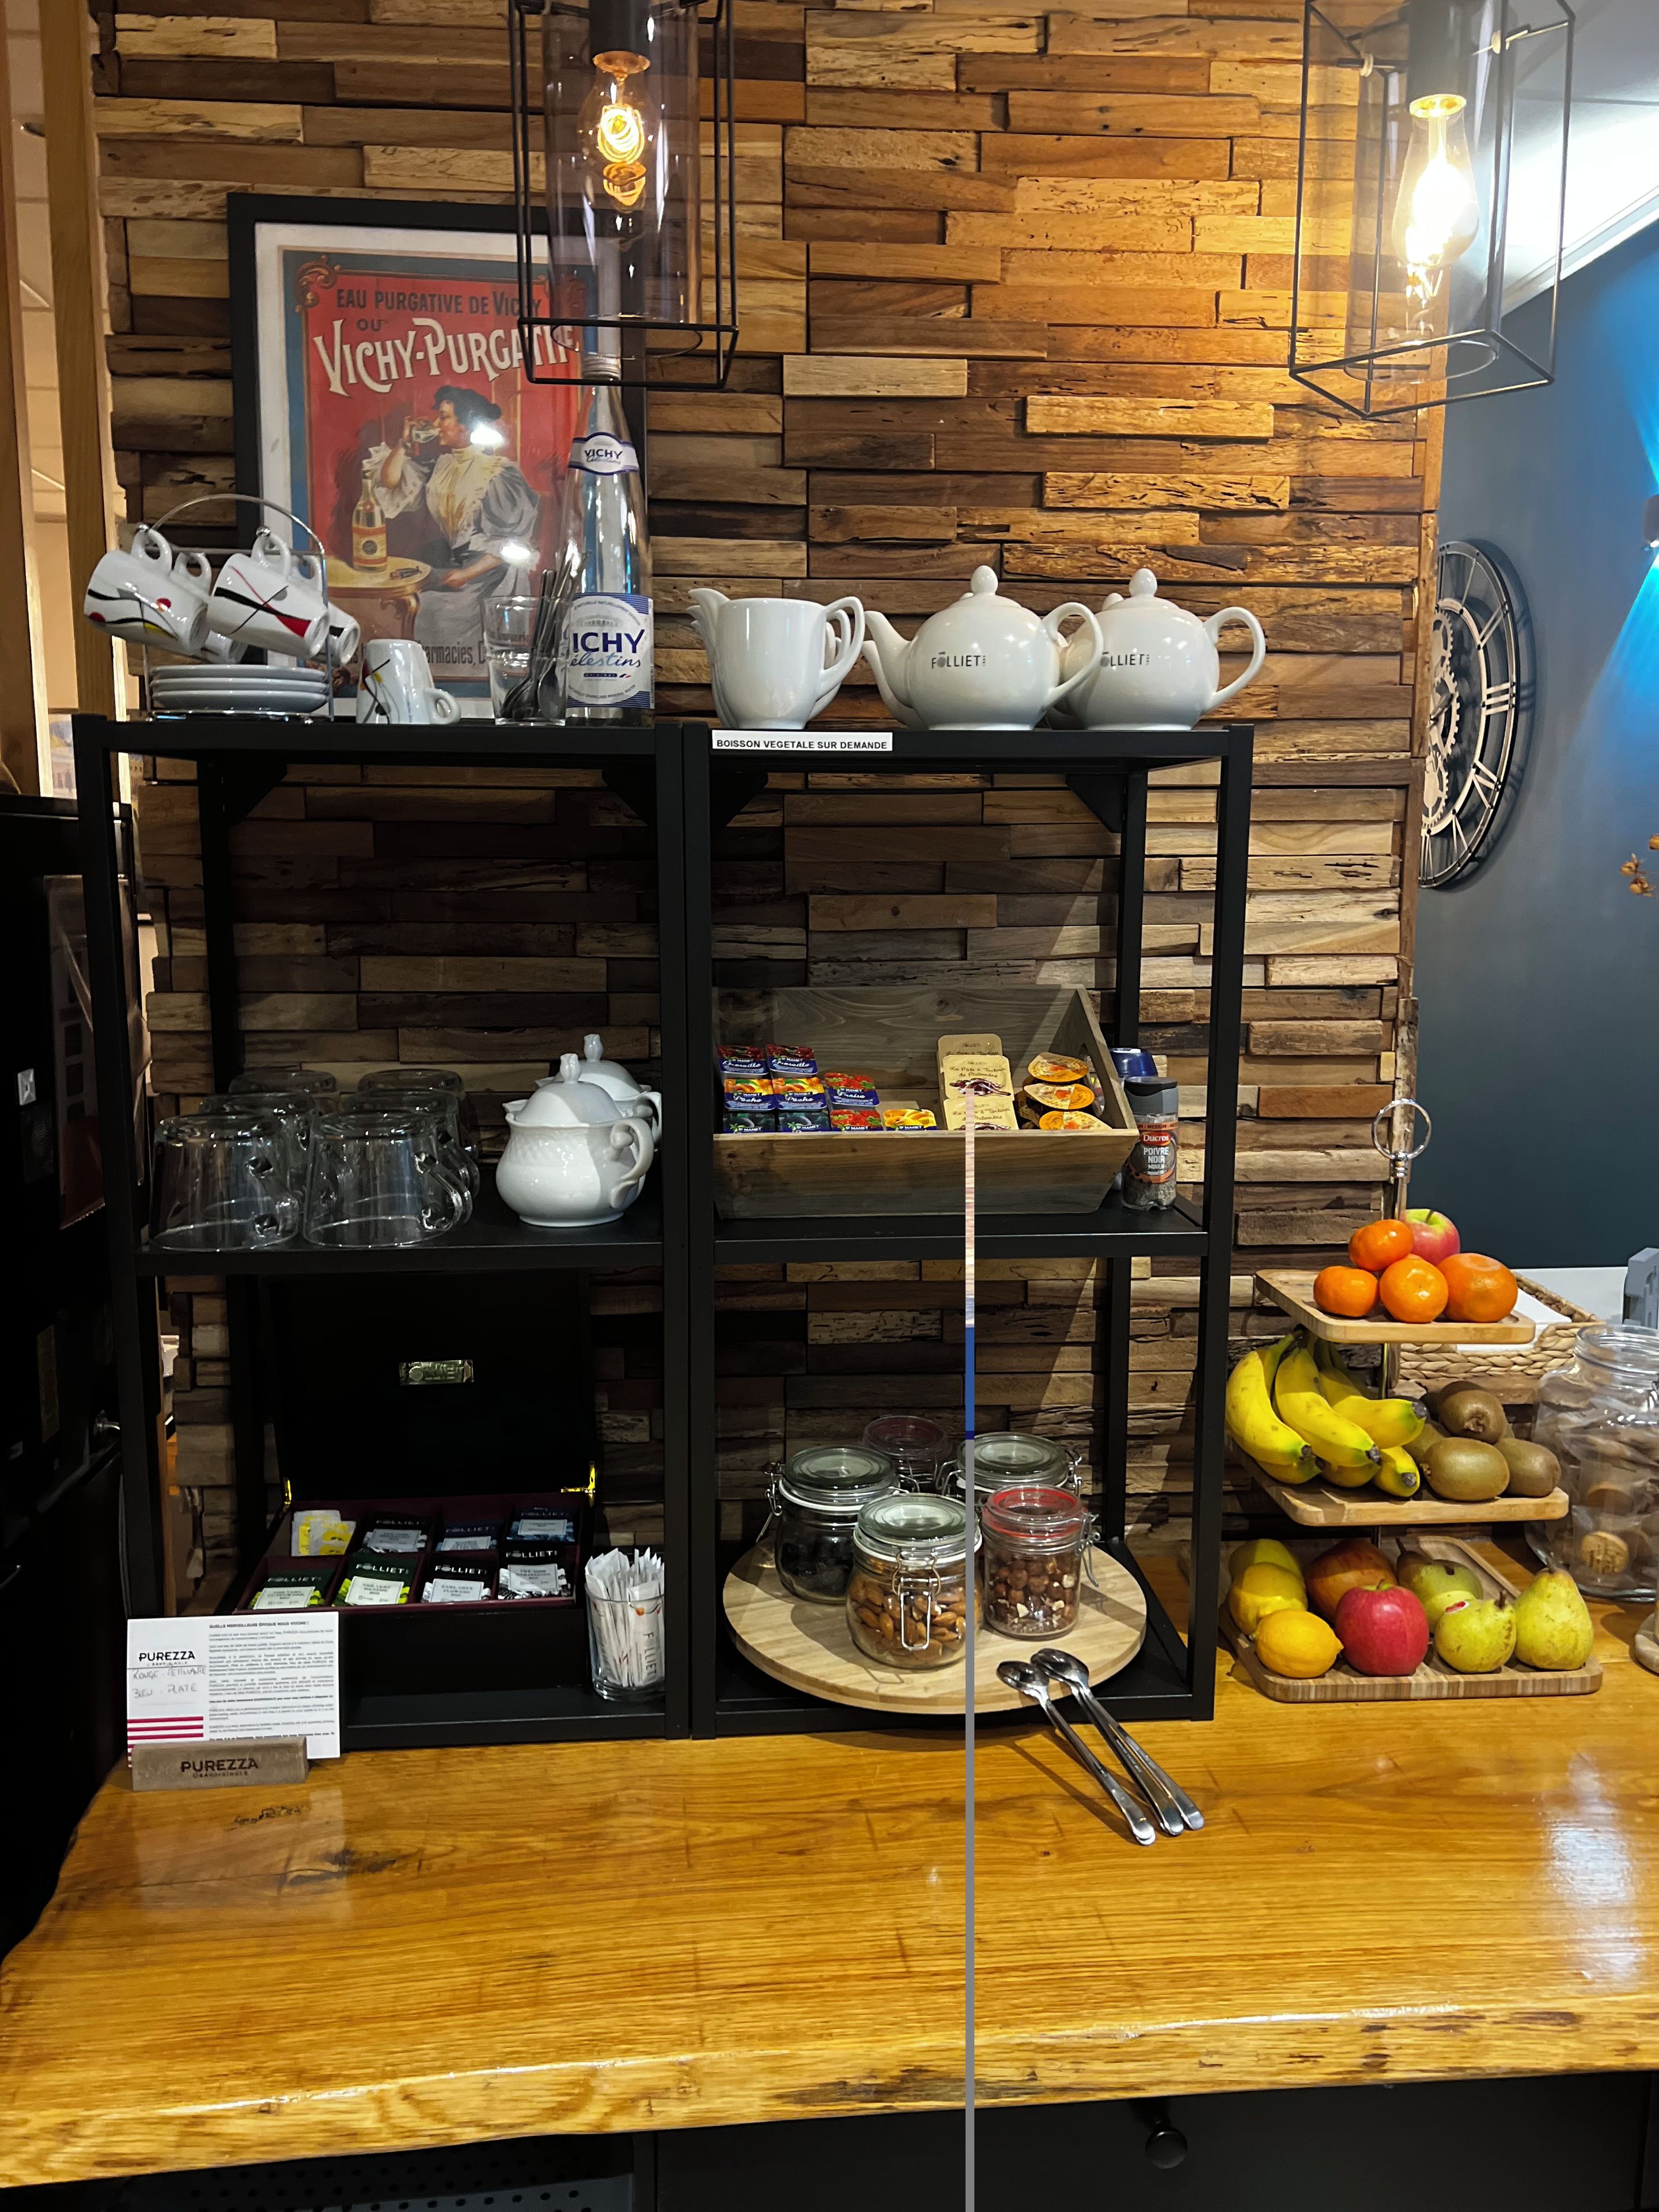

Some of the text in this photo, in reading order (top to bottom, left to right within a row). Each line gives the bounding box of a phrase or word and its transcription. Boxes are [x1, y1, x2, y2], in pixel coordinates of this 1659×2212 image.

[336, 289, 368, 309] EAU
[374, 290, 462, 314] PURGATIVE
[468, 296, 489, 315] DE
[357, 319, 387, 333] OU
[584, 449, 623, 460] VICHY
[573, 629, 645, 654] ICHY
[422, 641, 476, 666] armacies,
[569, 651, 641, 668] élestins
[931, 655, 981, 669] FOLLIET
[1100, 654, 1145, 667] OLLIET
[717, 740, 760, 748] BOISSON
[764, 741, 814, 749] VEGETALE
[817, 741, 837, 749] SUR
[1143, 1134, 1169, 1142] Ducros
[1143, 1147, 1169, 1156] POIVRE
[1147, 1155, 1165, 1164] NOIR
[506, 1550, 554, 1558] FOLLIET
[356, 1563, 405, 1574] FOLLIET
[434, 1565, 483, 1574] FOLLIET
[138, 1651, 195, 1662] PUREZZA
[643, 1632, 657, 1675] FLLIET
[180, 1758, 259, 1772] PUREZZA
